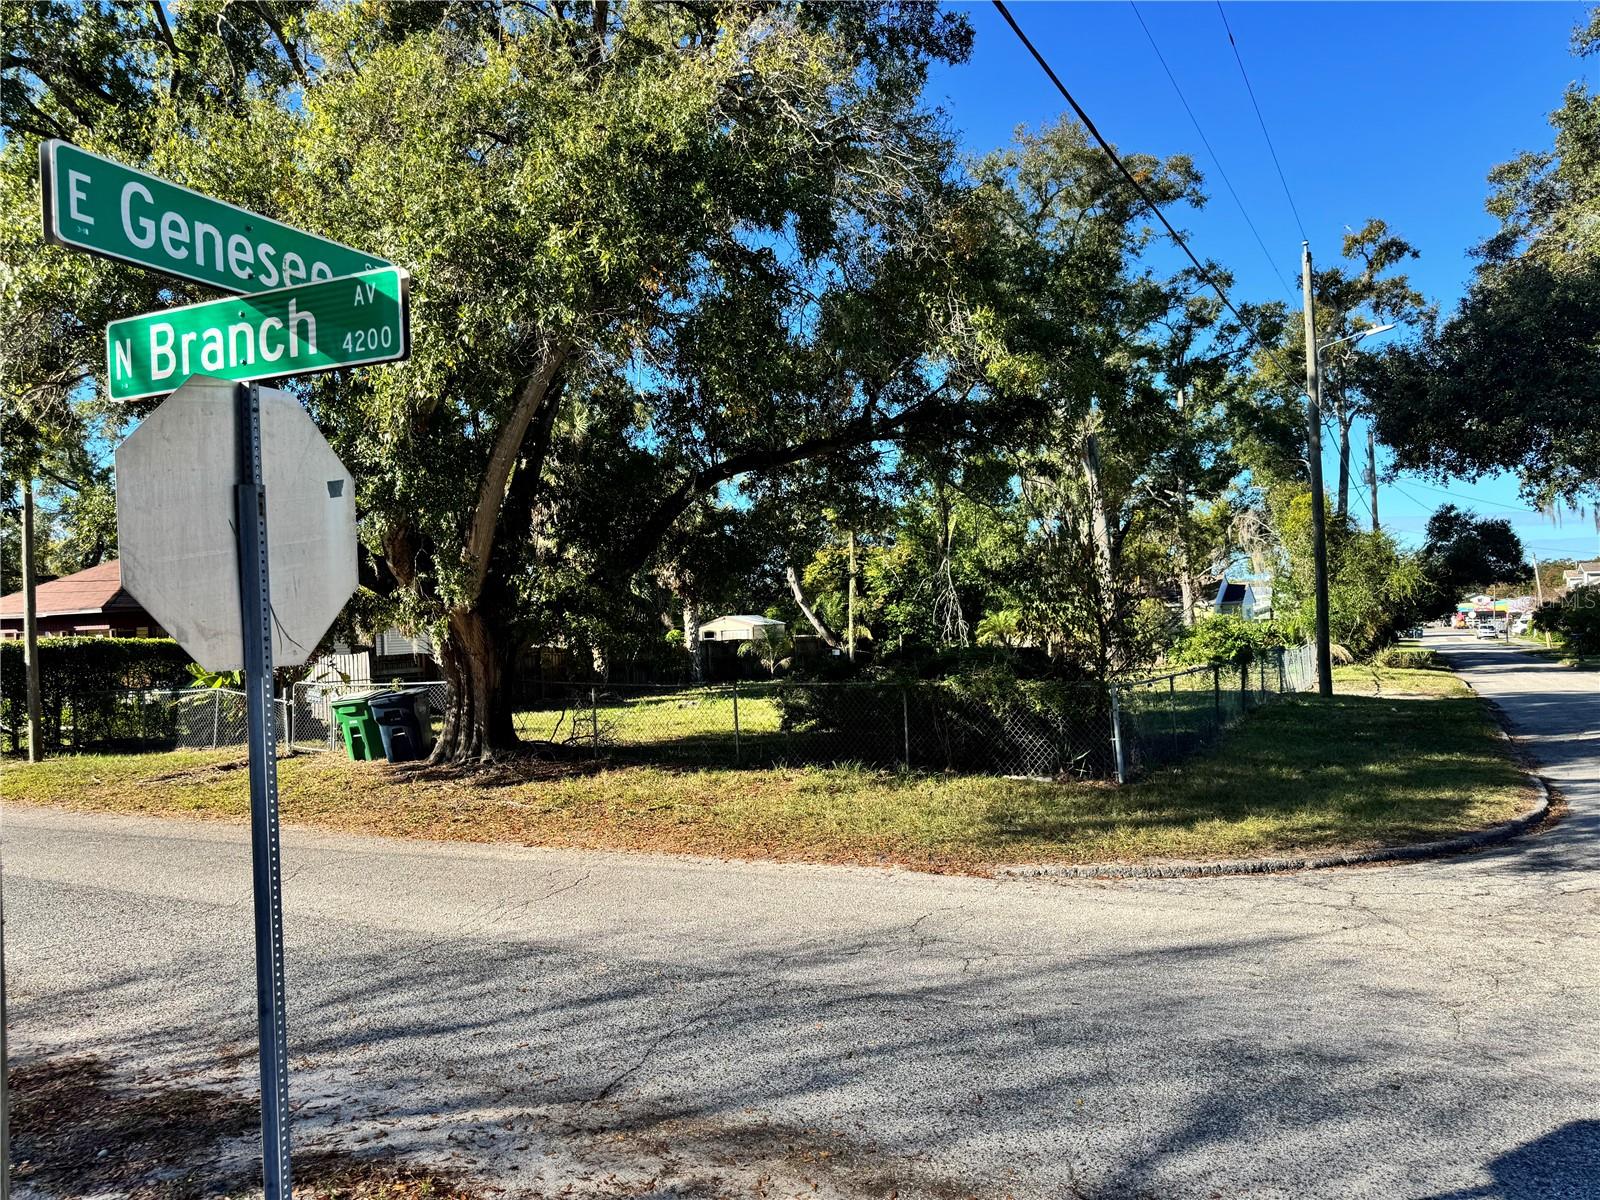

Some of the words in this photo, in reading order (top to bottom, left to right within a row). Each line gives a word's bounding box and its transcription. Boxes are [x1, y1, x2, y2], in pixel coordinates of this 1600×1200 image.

[69, 169, 95, 225] E
[120, 181, 334, 289] Genesee
[354, 282, 376, 306] AV
[115, 338, 133, 380] N
[150, 297, 318, 380] Branch
[342, 325, 392, 353] 4200
